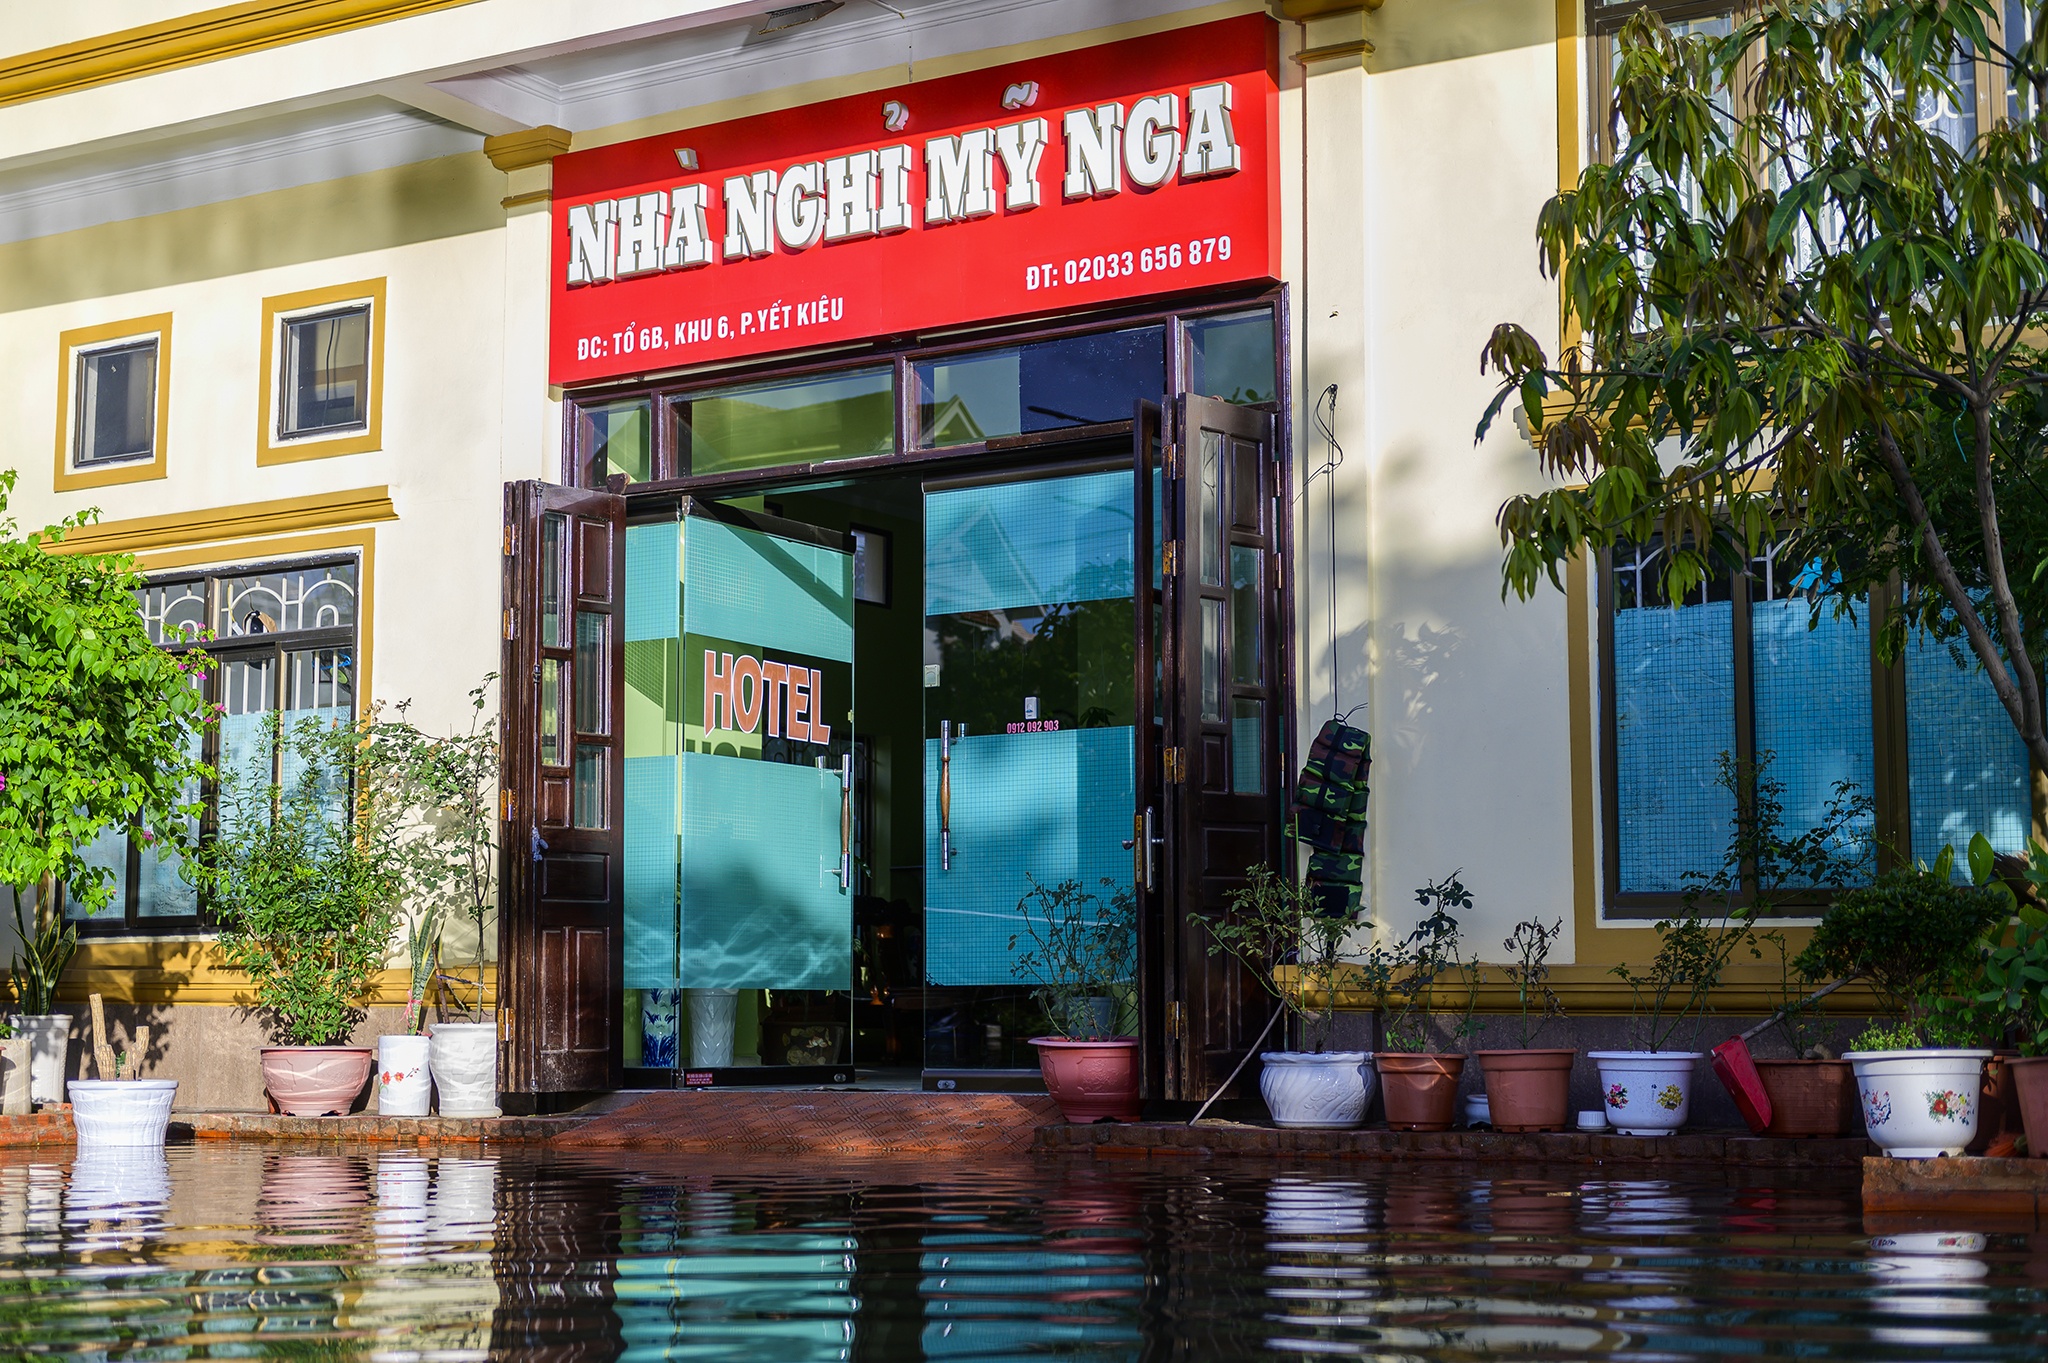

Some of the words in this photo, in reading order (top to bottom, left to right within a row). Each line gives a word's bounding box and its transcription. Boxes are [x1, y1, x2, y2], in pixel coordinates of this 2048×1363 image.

[567, 148, 713, 290] NHÀ
[723, 100, 912, 258] NGHỈ
[925, 81, 1048, 225] MỸ
[1063, 81, 1241, 200] NGA
[1026, 263, 1058, 291] ĐT:
[1064, 251, 1134, 284] 02033
[1140, 243, 1182, 273] 656
[1188, 235, 1232, 266] 879
[578, 336, 608, 361] ĐC:
[613, 321, 637, 355] TỔ
[639, 326, 669, 351] 6B,
[674, 318, 712, 345] KHU
[717, 316, 735, 340] 6,
[740, 299, 792, 335] P.YẾT
[797, 294, 844, 327] KIÊU
[704, 649, 831, 745] HOTEL
[1006, 722, 1025, 734] 0912
[1027, 720, 1042, 733] 092
[1043, 719, 1059, 731] 903
